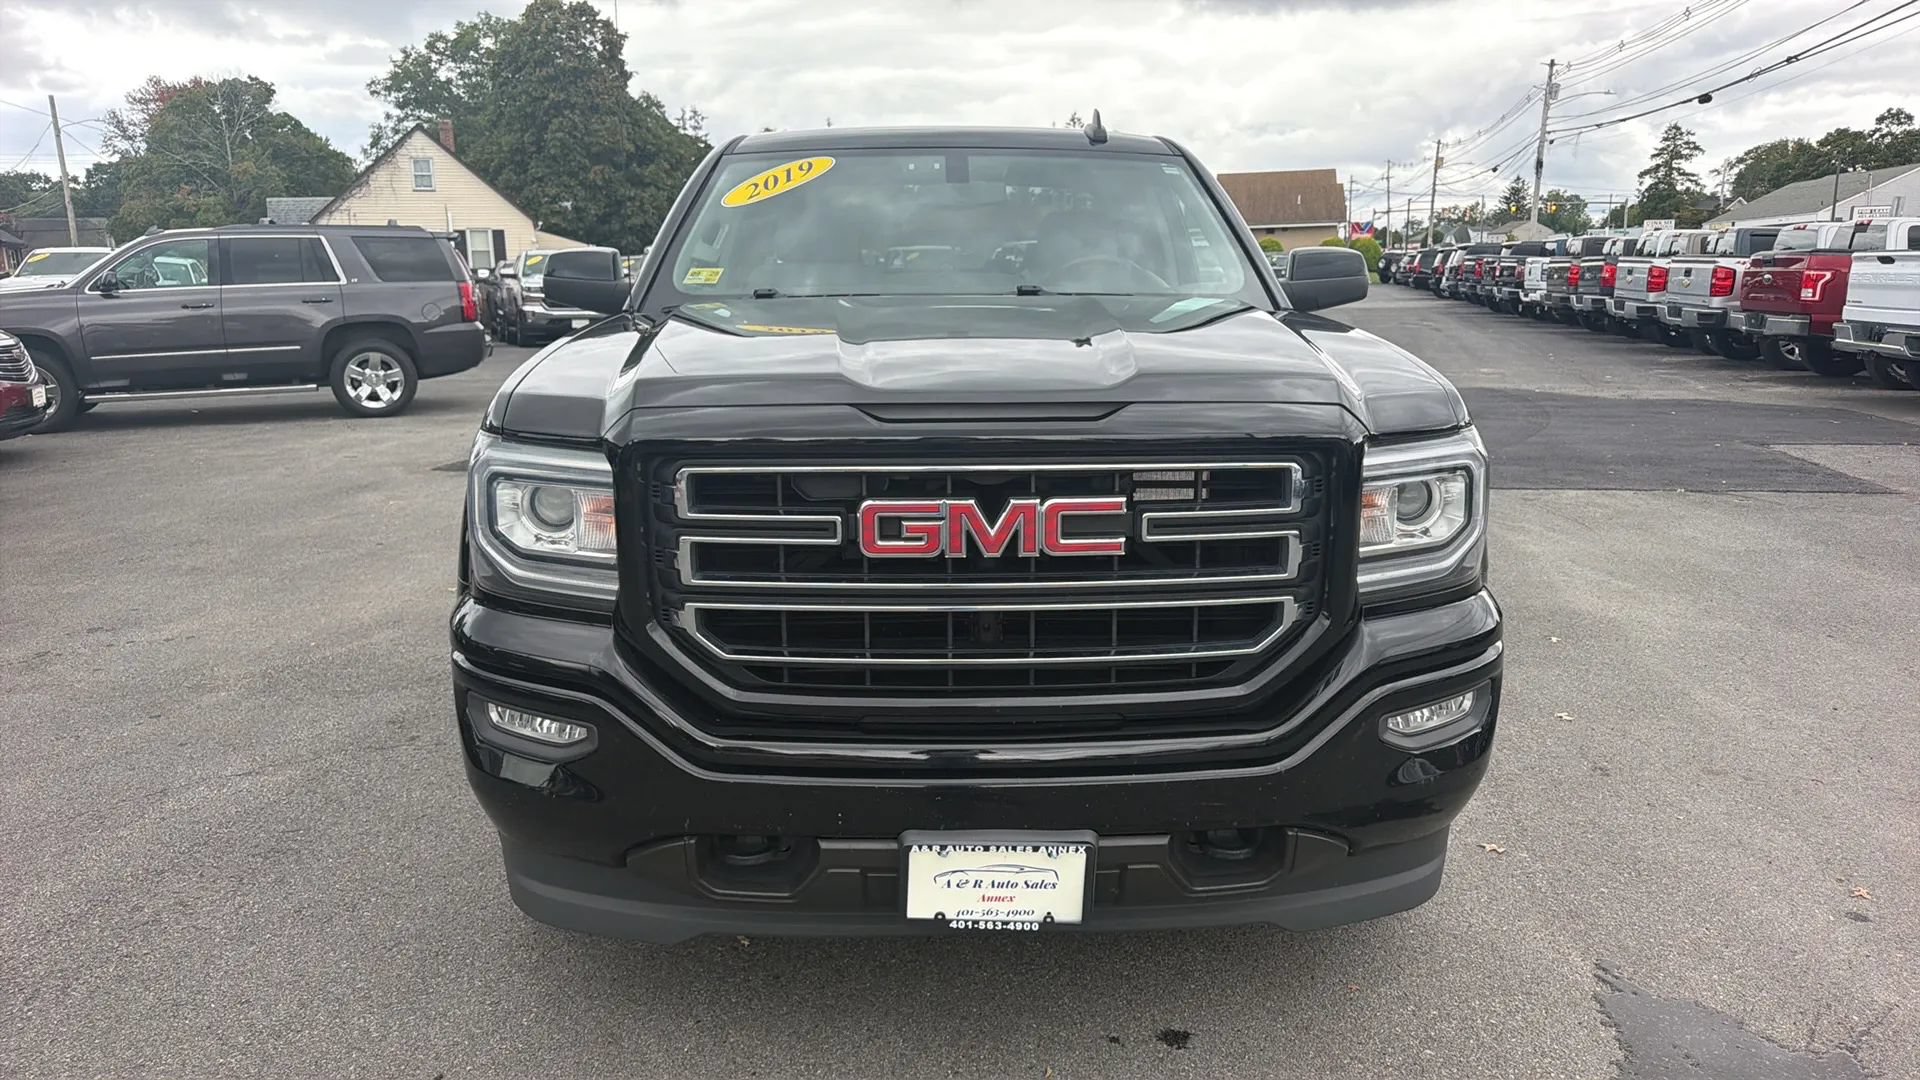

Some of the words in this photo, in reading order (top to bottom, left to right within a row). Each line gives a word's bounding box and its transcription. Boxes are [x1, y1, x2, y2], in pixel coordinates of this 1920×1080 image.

[745, 161, 814, 200] 2019
[858, 497, 1127, 558] GMC
[910, 845, 941, 853] A&R
[946, 845, 984, 853] AUTO
[1038, 846, 1087, 854] ANNEX
[941, 879, 952, 889] A
[956, 879, 970, 889] &
[972, 879, 984, 889] R
[985, 879, 1019, 889] Auto
[1022, 880, 1058, 890] Sales
[977, 893, 1016, 903] Annex
[954, 907, 1036, 917] 401-563-4900
[949, 920, 1040, 931] 401-563-4900
